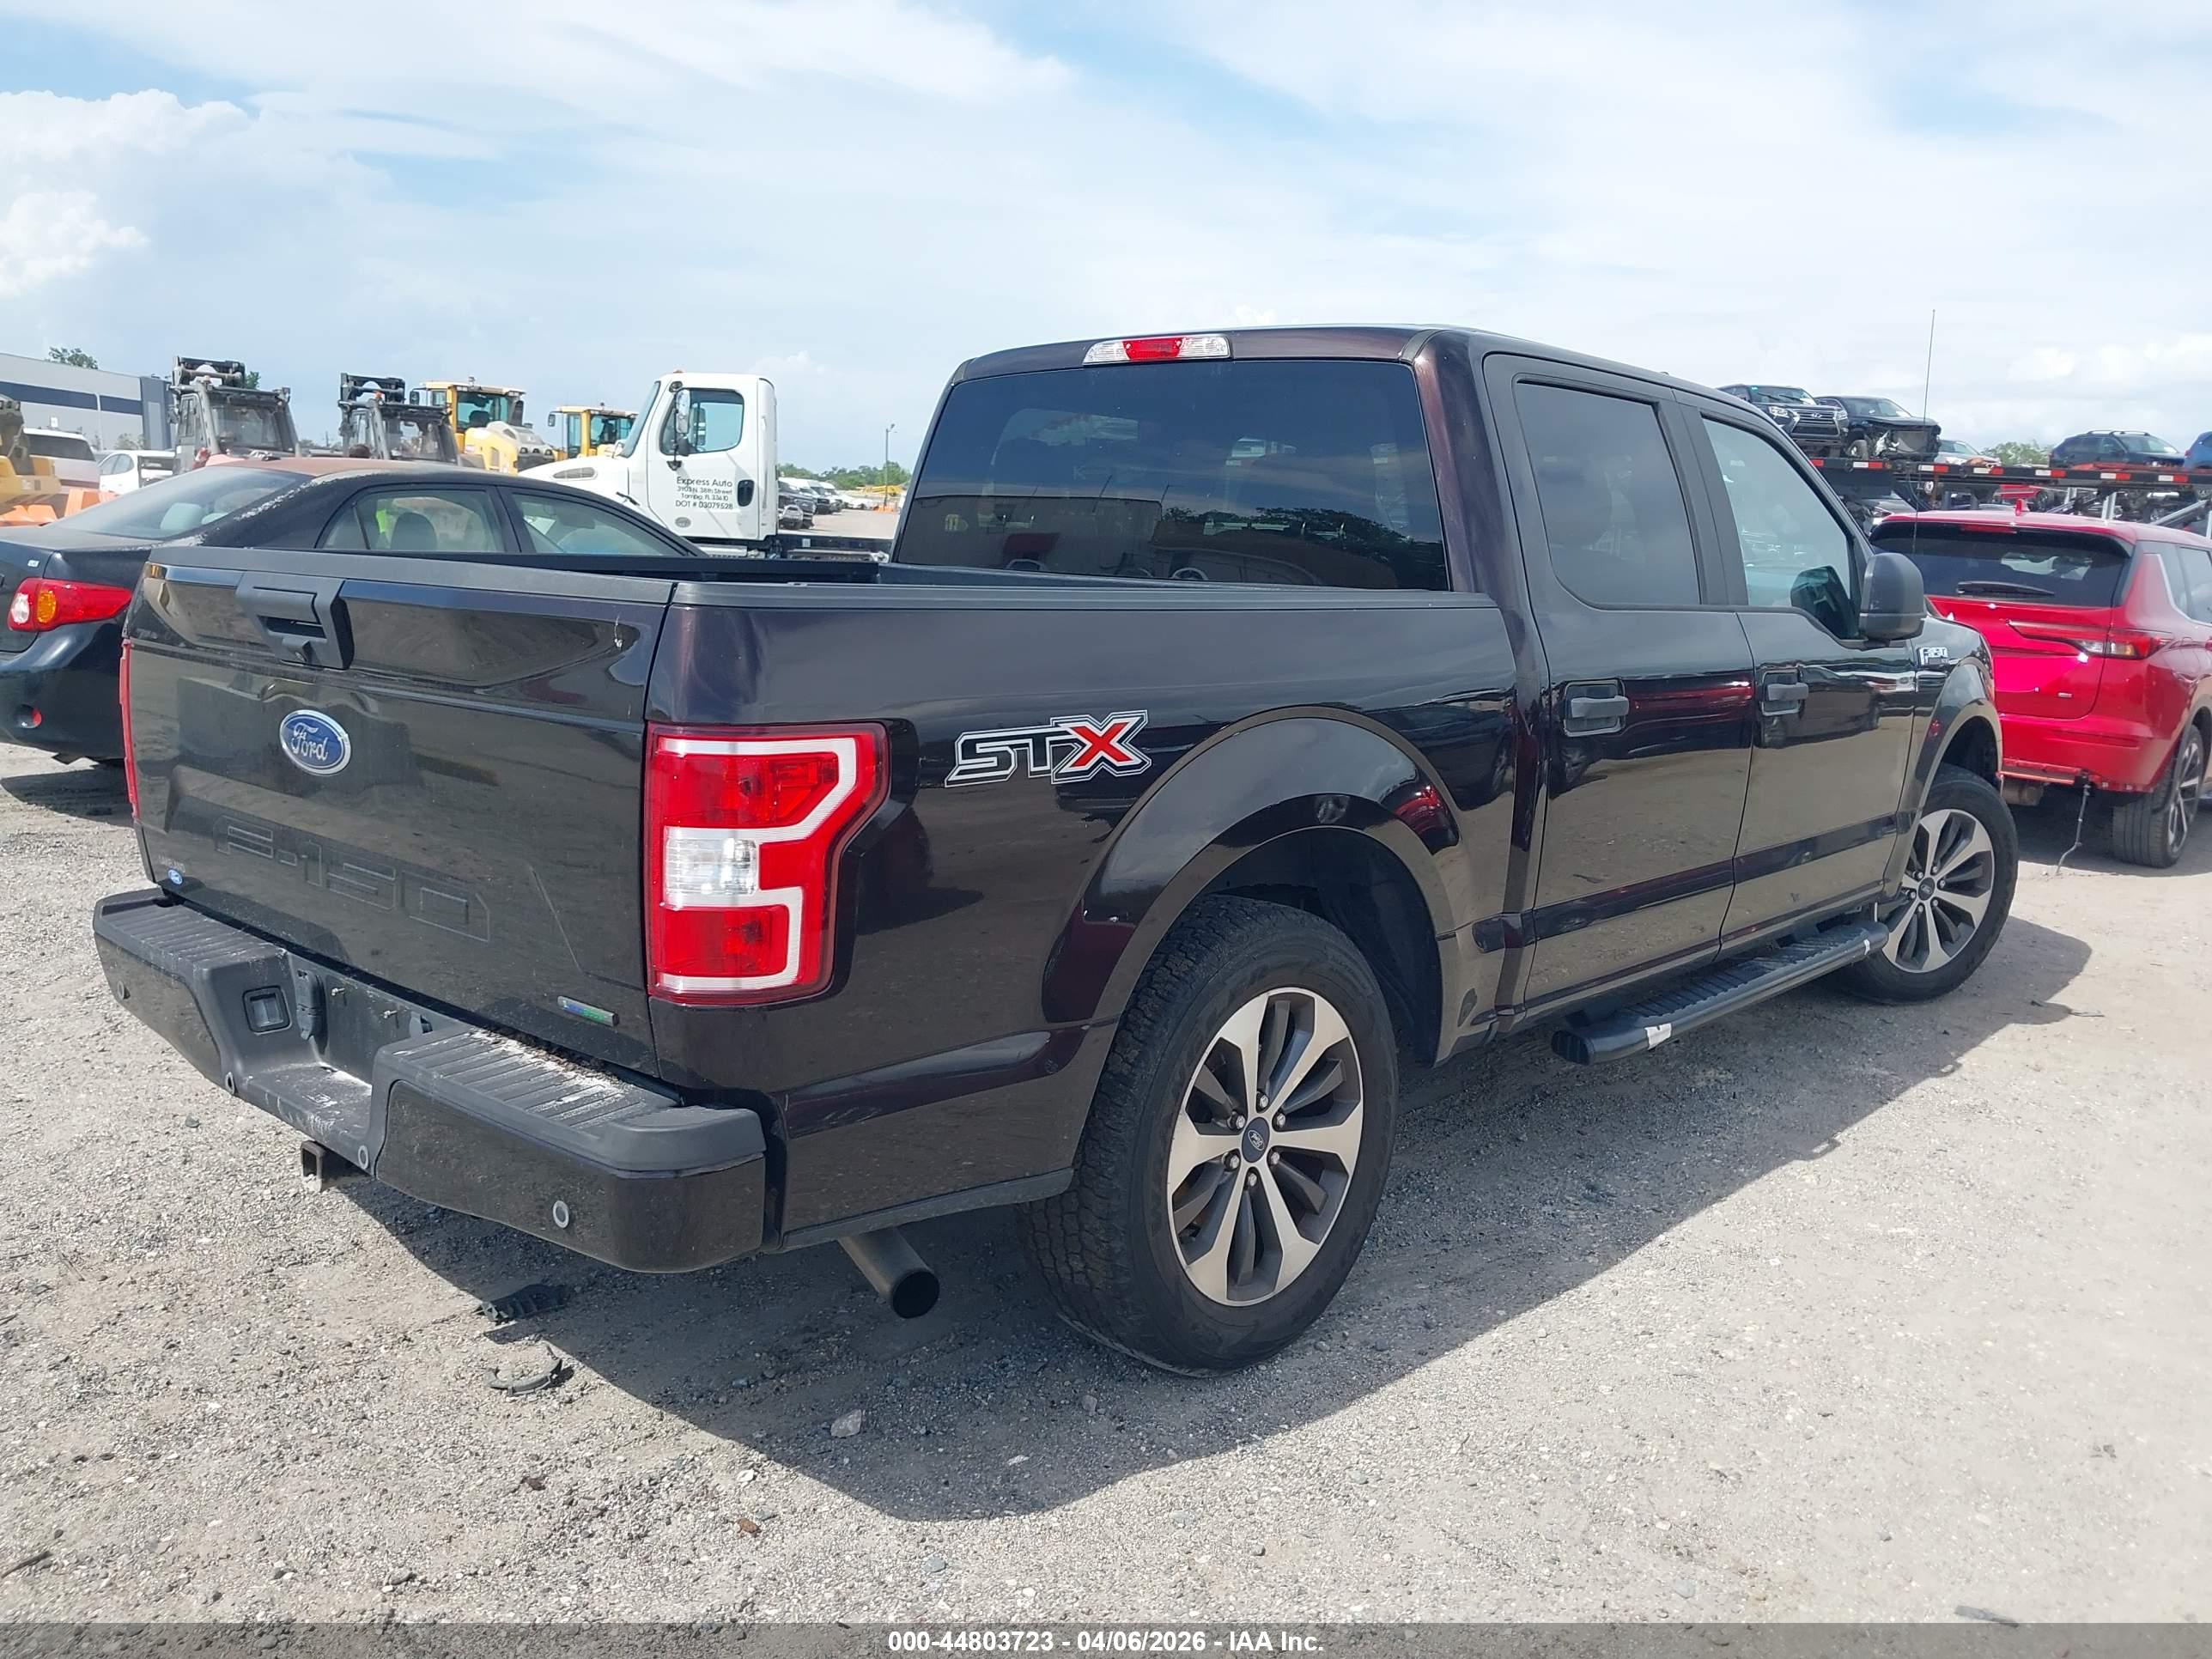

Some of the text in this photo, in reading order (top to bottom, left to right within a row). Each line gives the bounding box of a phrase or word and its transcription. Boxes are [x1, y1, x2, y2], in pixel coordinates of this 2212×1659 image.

[677, 476, 733, 488] Express Auto
[291, 722, 329, 761] Ford
[945, 709, 1152, 787] STX
[213, 815, 489, 942] F-150
